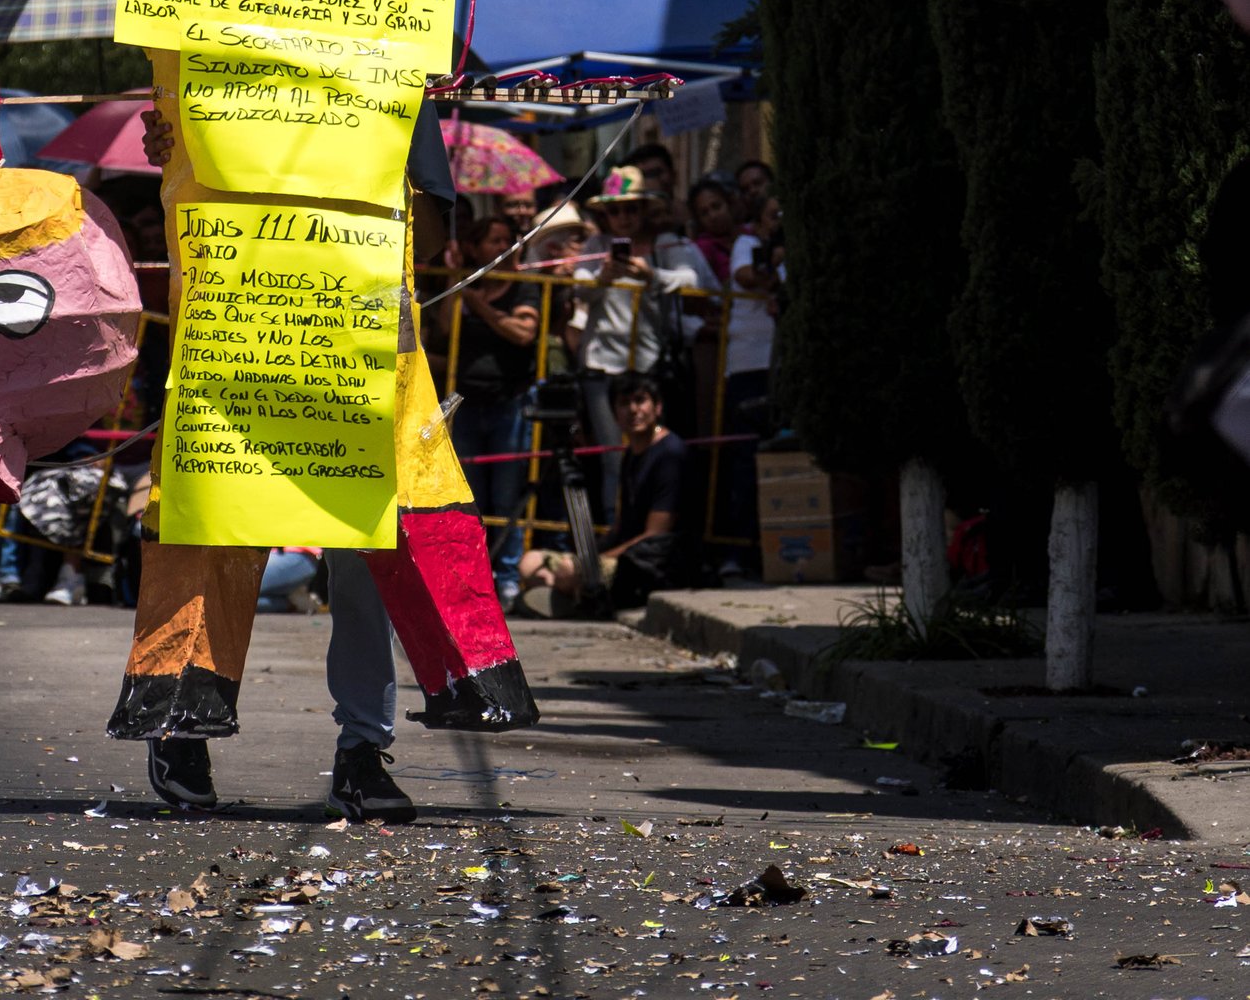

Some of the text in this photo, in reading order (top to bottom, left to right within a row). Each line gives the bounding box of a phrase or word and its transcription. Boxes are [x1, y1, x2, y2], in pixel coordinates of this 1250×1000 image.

[124, 1, 179, 20] LABOR
[239, 0, 332, 22] ENFERMERIA
[343, 11, 349, 25] Y
[352, 12, 377, 26] SU
[385, 13, 431, 31] GRAN
[386, 0, 408, 13] SU
[186, 23, 392, 60] EL SECRETARIO DEL
[186, 54, 424, 88] SINDICATO DEL IMSS
[183, 82, 411, 119] NO APOYA AL PERSONAL
[189, 105, 359, 127] SINDICALIZADO
[180, 208, 243, 241] JUDAS
[251, 214, 296, 241] 111
[189, 242, 237, 260] SARIO
[200, 272, 224, 285] LOS
[241, 269, 315, 290] MEDIOS
[320, 272, 353, 293] DE
[187, 286, 387, 311] COMUNICACION POR SER
[184, 304, 382, 330] CASOS QUE SE MANDAN LOS
[184, 325, 333, 348] MENSAJES Y NO LOS
[265, 350, 296, 366] LOS
[301, 351, 356, 370] DEJAN
[363, 354, 385, 370] AL
[234, 370, 296, 385] NADAMAS
[304, 375, 331, 386] NOS
[337, 377, 366, 387] DAN
[178, 385, 215, 398] ATOLE
[220, 388, 248, 400] CON
[254, 389, 268, 401] EL
[177, 402, 371, 424] MENTE VAN A LOS QUE LES
[175, 416, 250, 433] CONVIENEN
[175, 437, 236, 454] ALGUNOS
[173, 454, 385, 478] REPORTEROS SON GROSEROS
